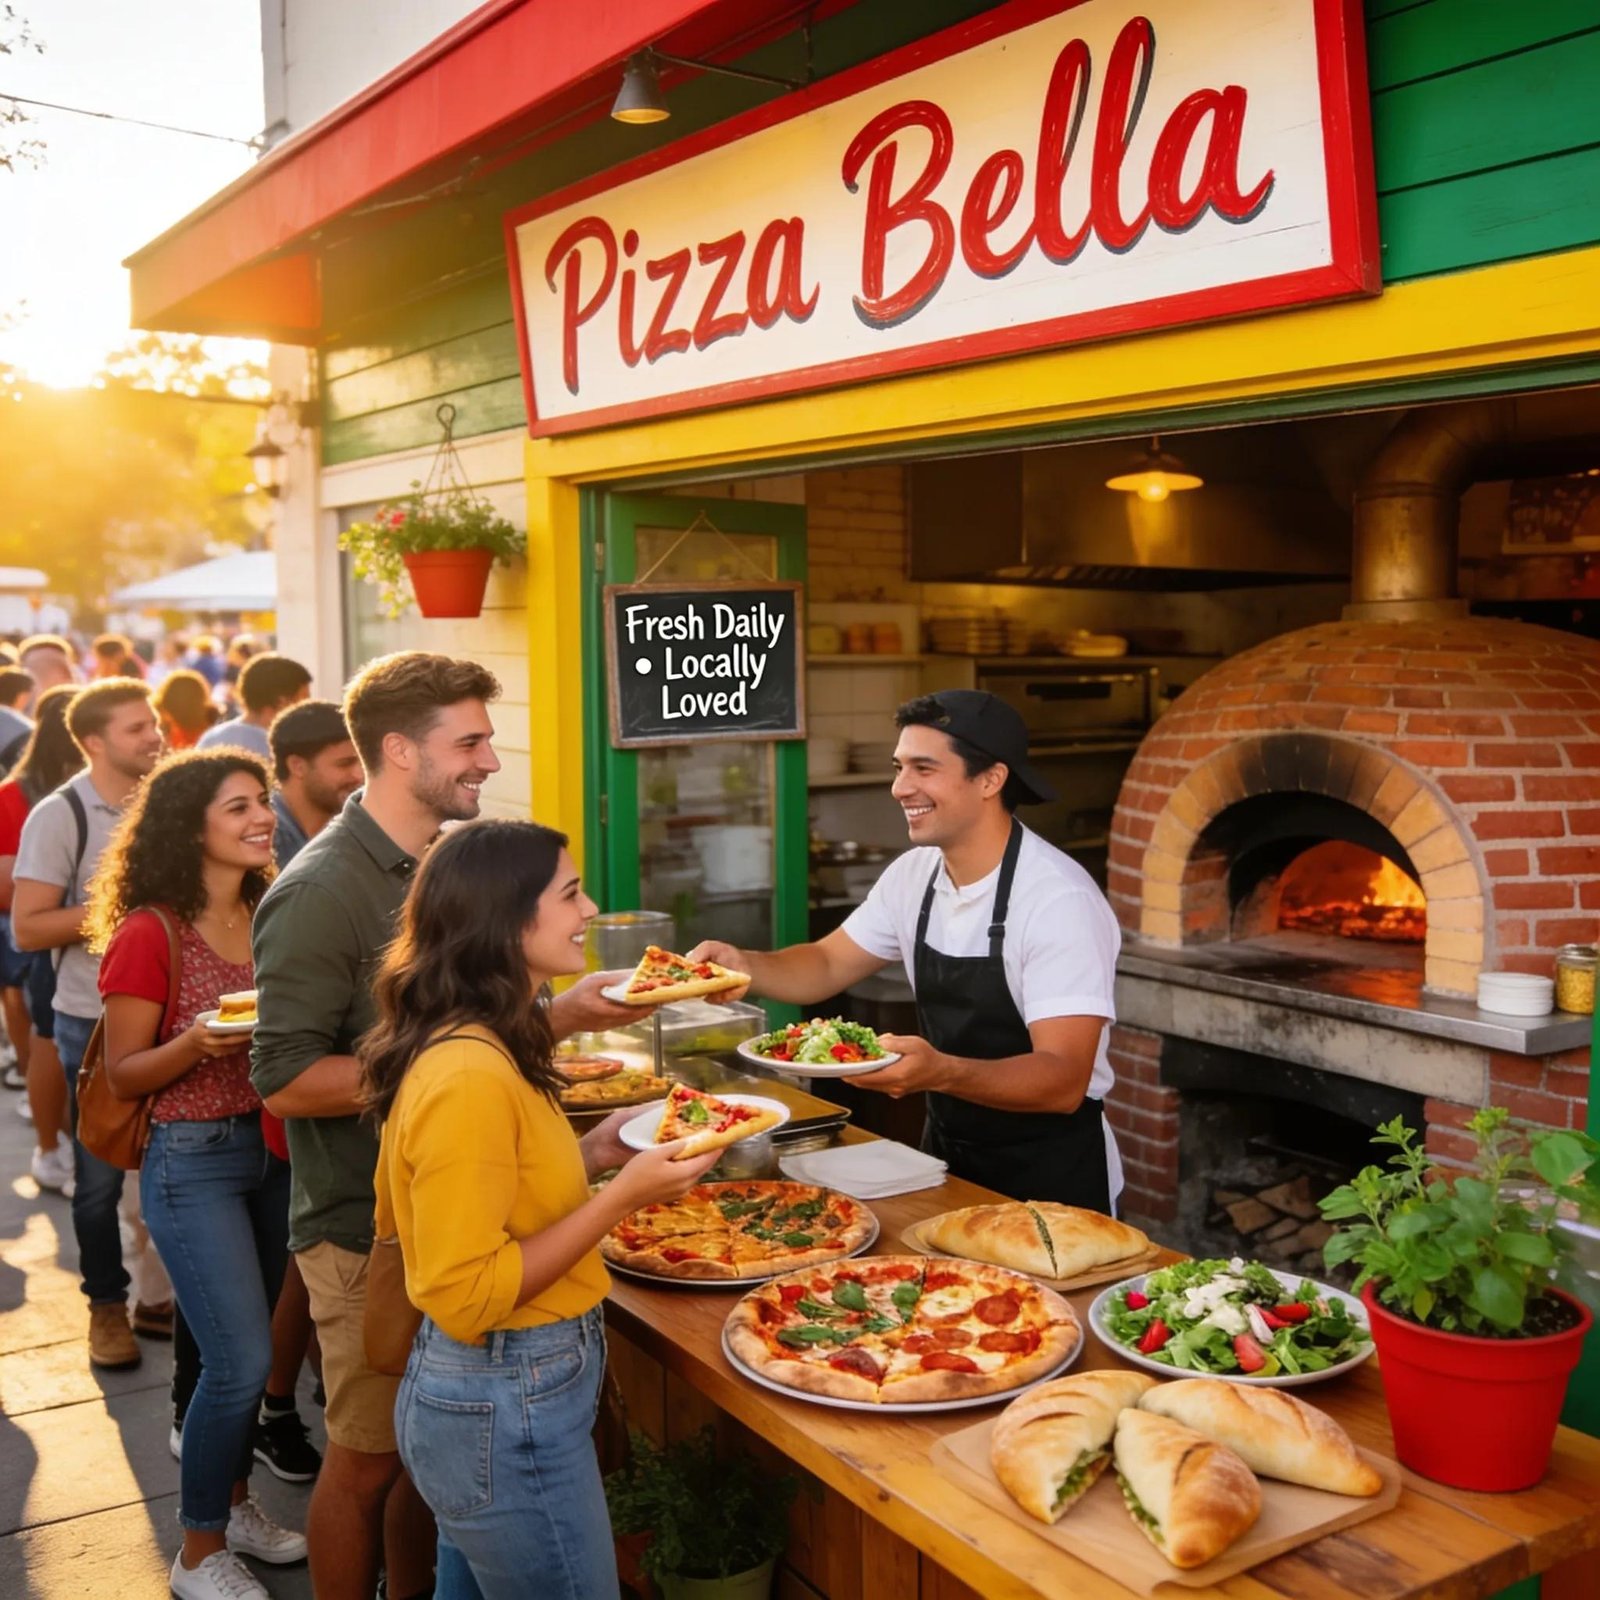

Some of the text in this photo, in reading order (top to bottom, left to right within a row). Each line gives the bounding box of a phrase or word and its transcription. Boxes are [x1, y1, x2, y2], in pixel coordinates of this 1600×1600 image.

[545, 16, 1275, 395] Pizza Bella
[625, 602, 785, 648] Fresh Daily
[665, 643, 766, 689] Locally
[662, 681, 747, 720] Loved
